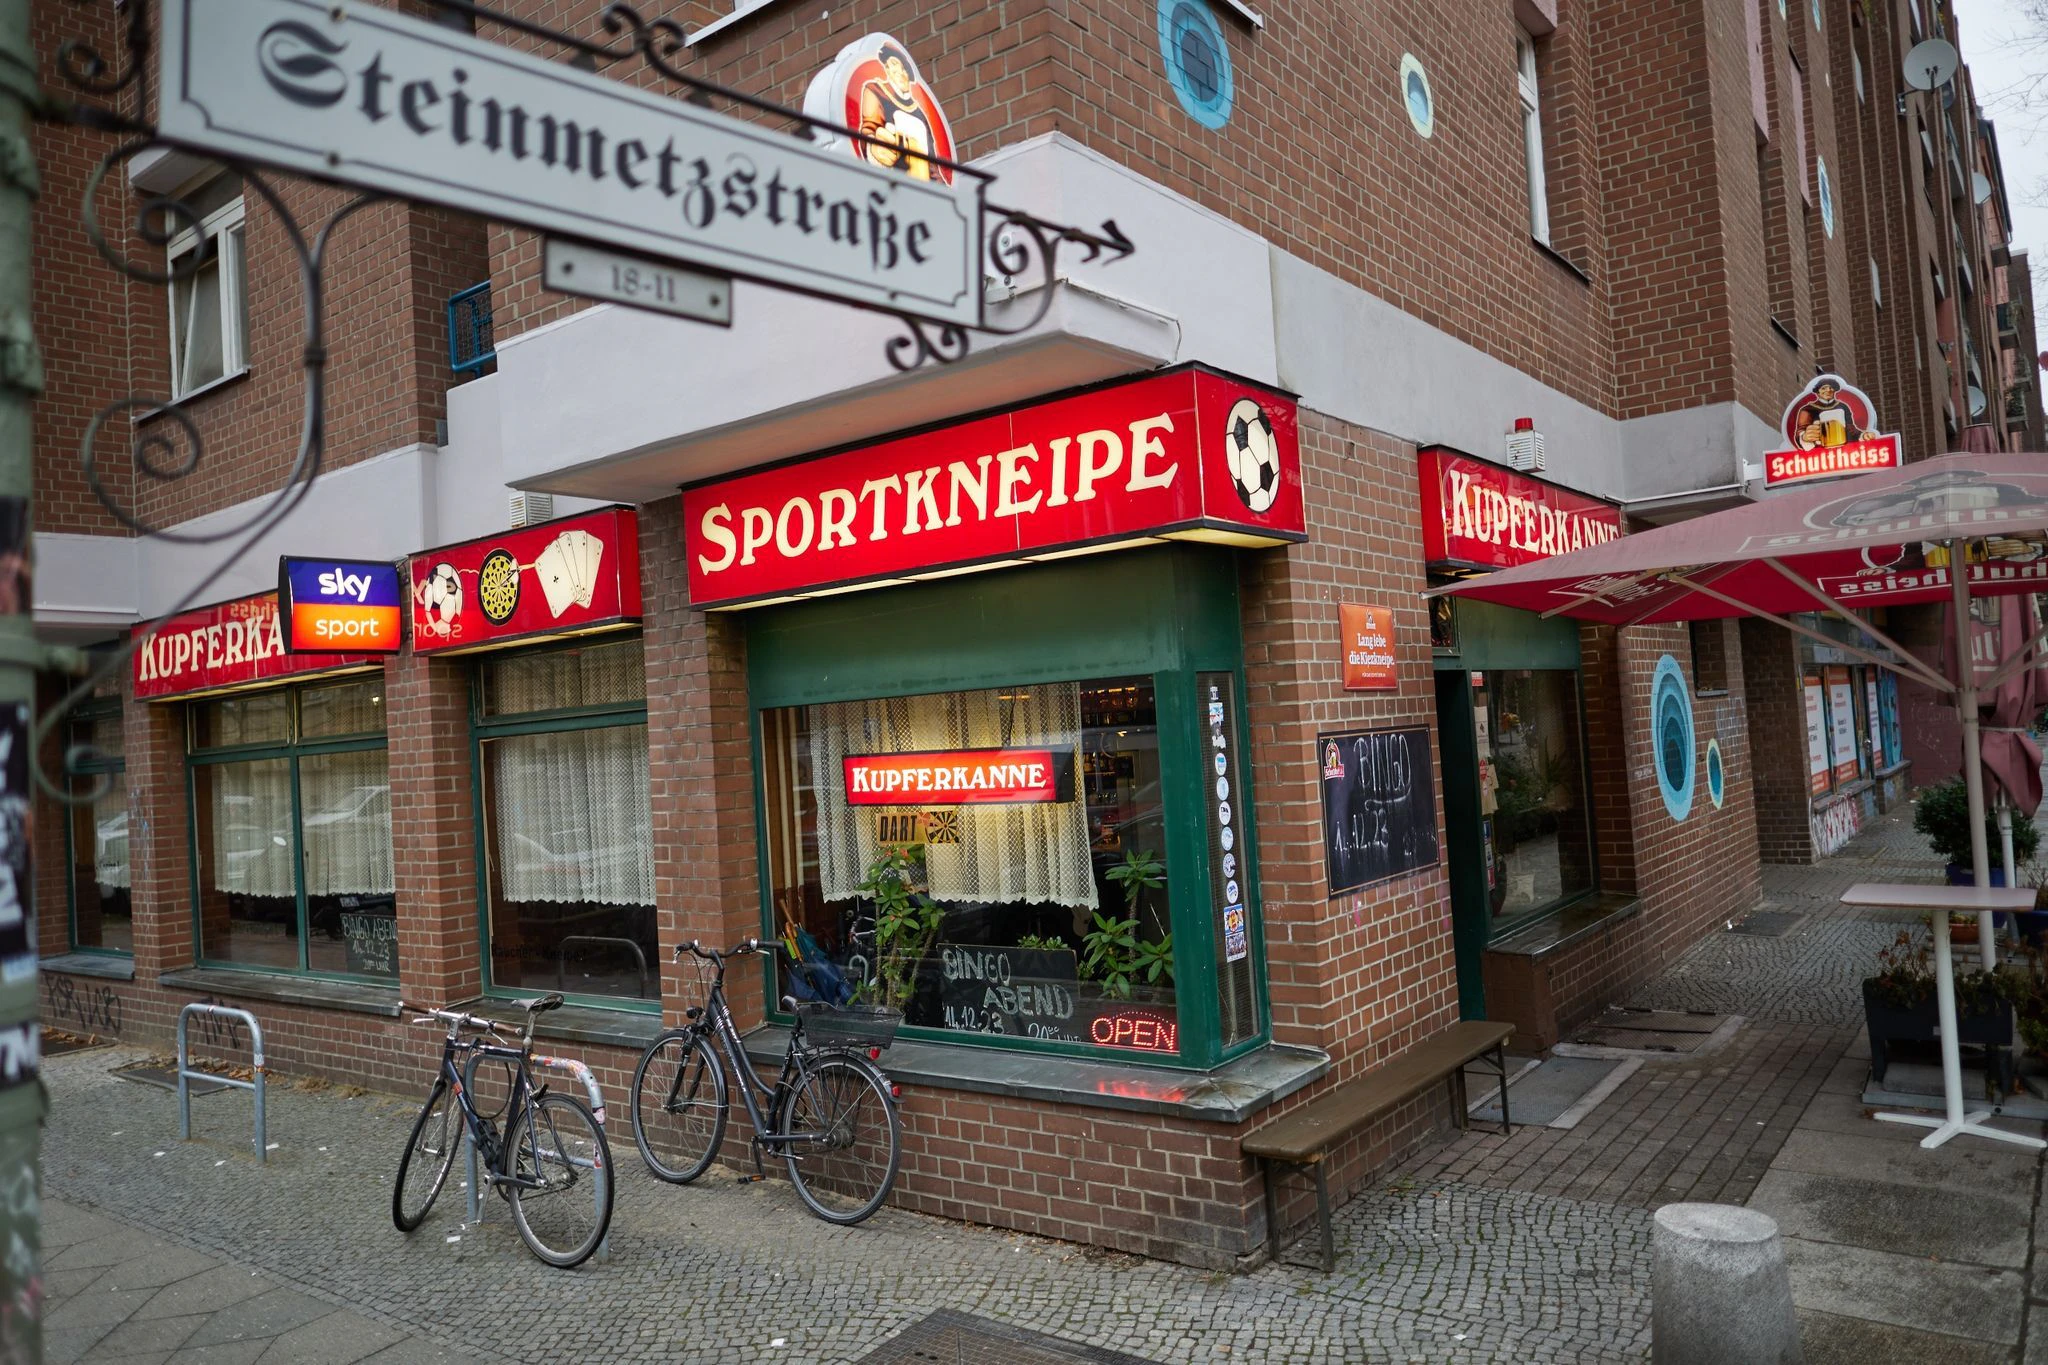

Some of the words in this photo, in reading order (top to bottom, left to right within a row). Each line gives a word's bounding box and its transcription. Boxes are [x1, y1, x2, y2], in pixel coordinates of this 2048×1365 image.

[257, 20, 932, 272] Steinmetzstraße
[611, 264, 675, 301] 18-11
[1772, 445, 1890, 477] Schultheiss
[698, 413, 1179, 576] SPORTKNEIPE
[318, 567, 372, 603] sky
[315, 617, 380, 640] sport
[1357, 632, 1373, 649] Lang
[1373, 633, 1386, 647] lebe
[1349, 651, 1360, 665] die
[852, 763, 1047, 793] KUPFERKANNE
[879, 815, 918, 842] DART
[942, 948, 1011, 987] BINGO
[983, 983, 1075, 1020] ABEND
[1092, 1017, 1176, 1050] OPEN
